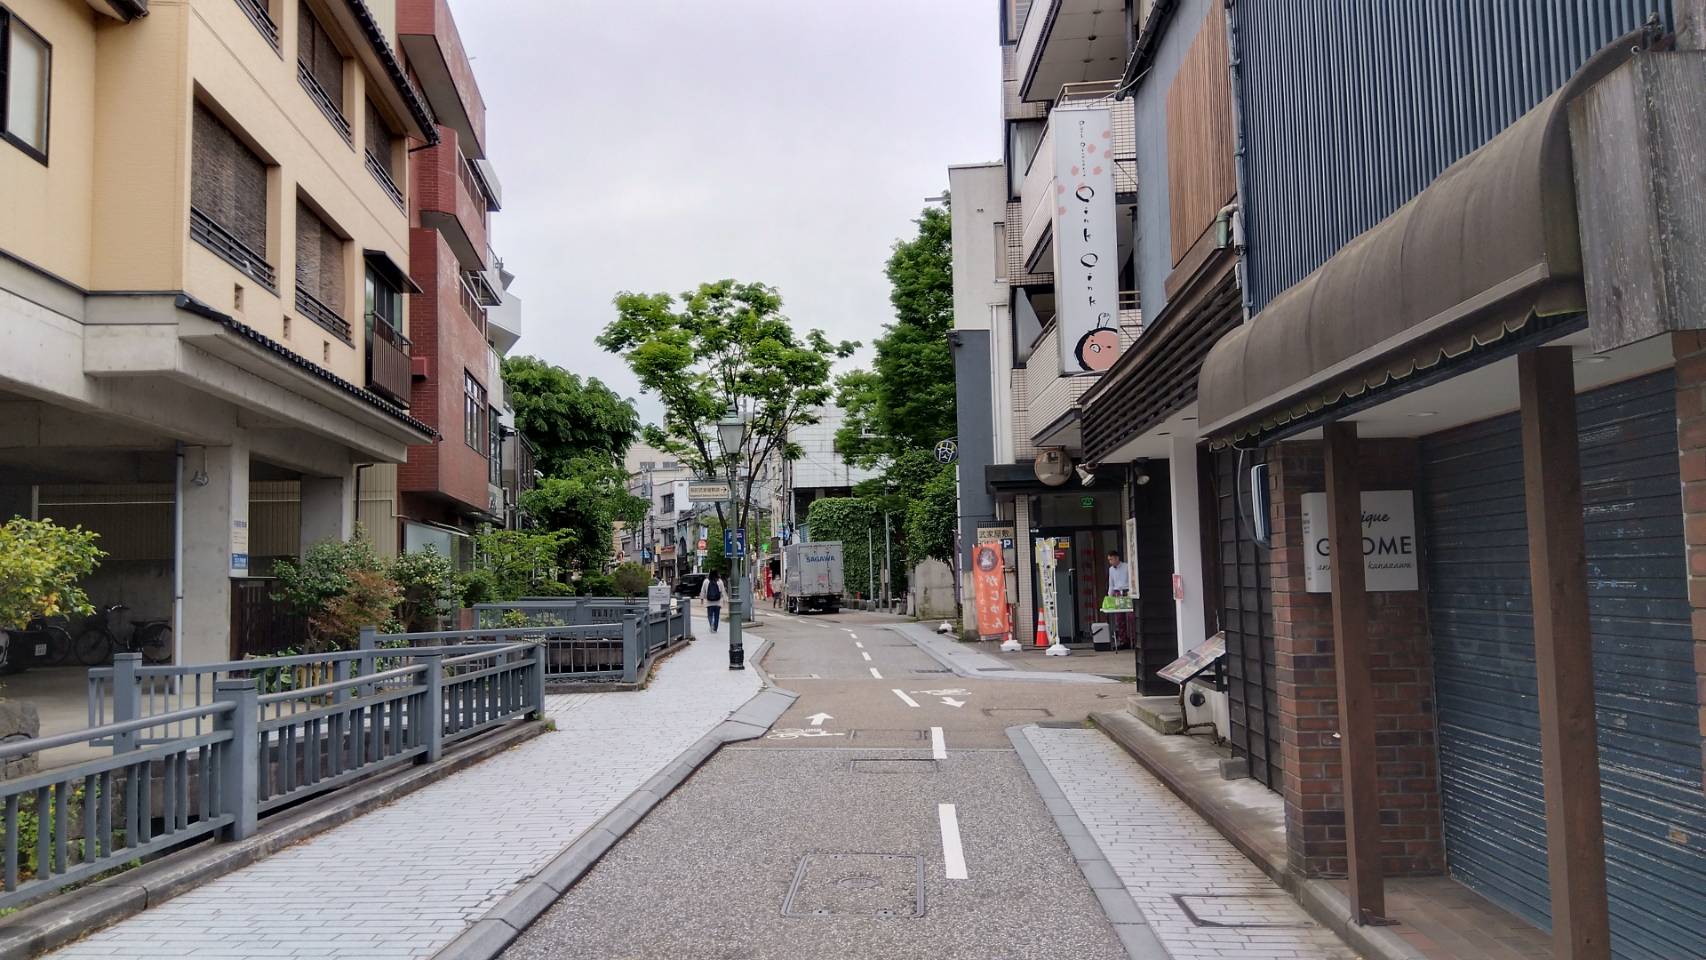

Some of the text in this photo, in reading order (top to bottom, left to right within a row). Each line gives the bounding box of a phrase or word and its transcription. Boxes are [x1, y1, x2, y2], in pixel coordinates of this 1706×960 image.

[1361, 511, 1391, 528] ique
[1003, 539, 1011, 548] P
[806, 555, 835, 563] SAGAWA
